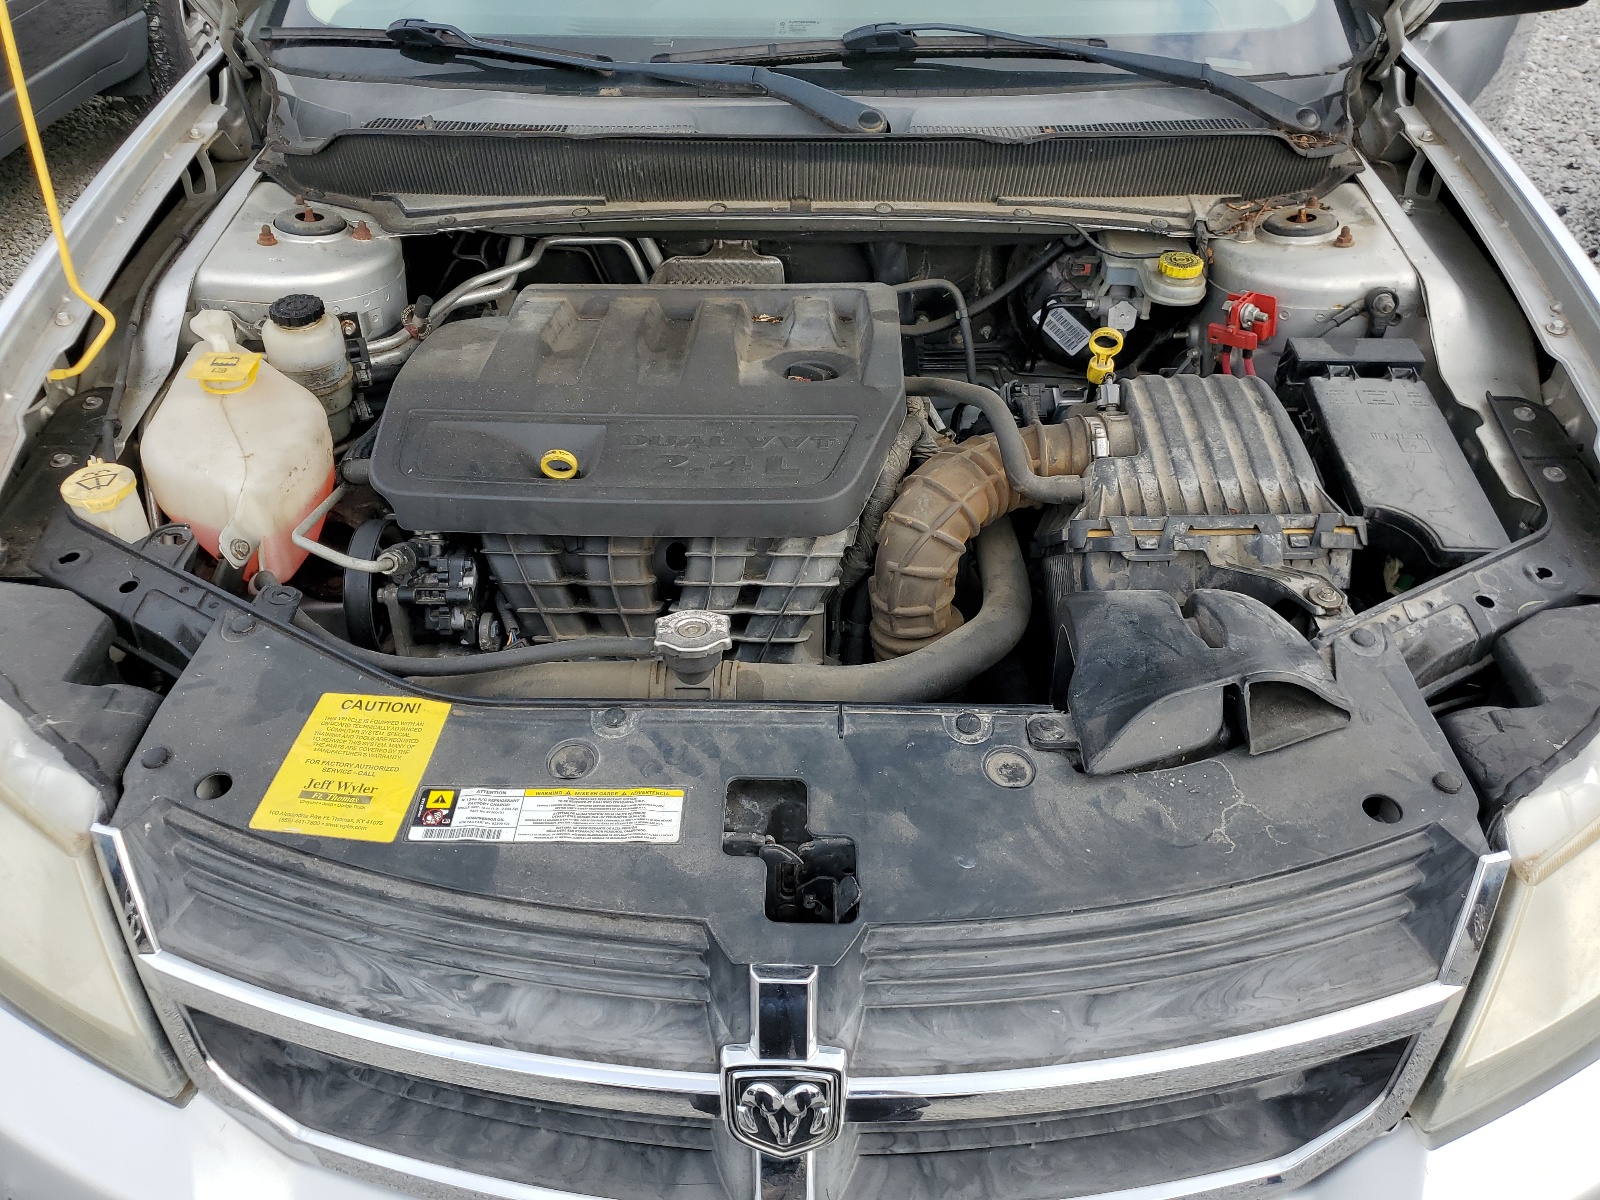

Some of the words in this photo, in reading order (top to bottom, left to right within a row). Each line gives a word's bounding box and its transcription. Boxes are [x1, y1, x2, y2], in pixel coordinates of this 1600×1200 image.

[745, 435, 840, 450] VVT
[341, 699, 422, 714] CAUTION!
[327, 726, 359, 734] COMPUTER
[321, 760, 354, 768] FACTORY
[354, 763, 400, 772] AUTHORIZED
[304, 777, 334, 790] Jeff
[337, 780, 378, 794] Wyler
[311, 792, 323, 800] Ft.
[326, 793, 360, 803] Thomas
[332, 815, 355, 824] Thomas,
